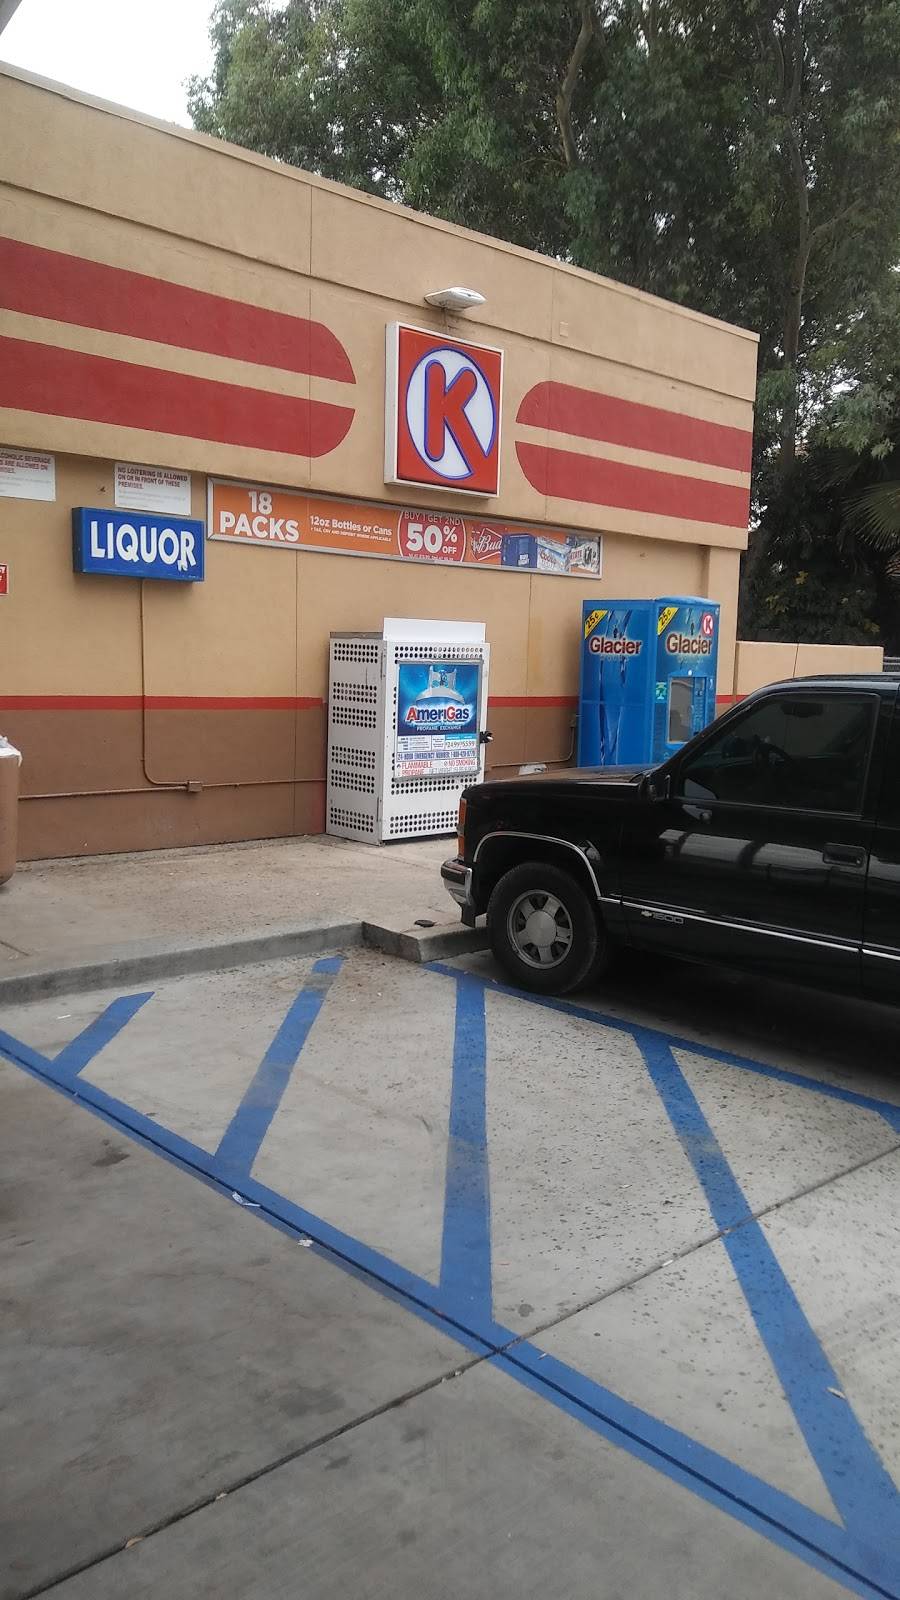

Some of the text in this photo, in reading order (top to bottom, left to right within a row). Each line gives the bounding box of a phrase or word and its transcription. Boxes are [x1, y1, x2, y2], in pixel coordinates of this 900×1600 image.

[421, 357, 490, 477] K
[127, 468, 156, 478] LOITERING
[163, 472, 188, 482] ALLOWED
[141, 476, 157, 484] FRONT
[165, 480, 181, 488] THESE
[248, 490, 273, 515] 18
[219, 511, 300, 542] PACKS
[310, 515, 392, 536] 12oz Bottles or Cans
[404, 511, 420, 520] BUY
[427, 515, 443, 523] GET
[445, 517, 461, 526] 2ND
[90, 520, 197, 571] LIQUOR
[406, 522, 458, 554] 50%
[442, 546, 457, 555] OFF
[589, 636, 642, 654] Glacier
[666, 632, 713, 655] Glacier
[406, 706, 470, 721] AmeriGas
[401, 761, 433, 769] FLAMMABLE
[455, 759, 476, 767] SMOKING
